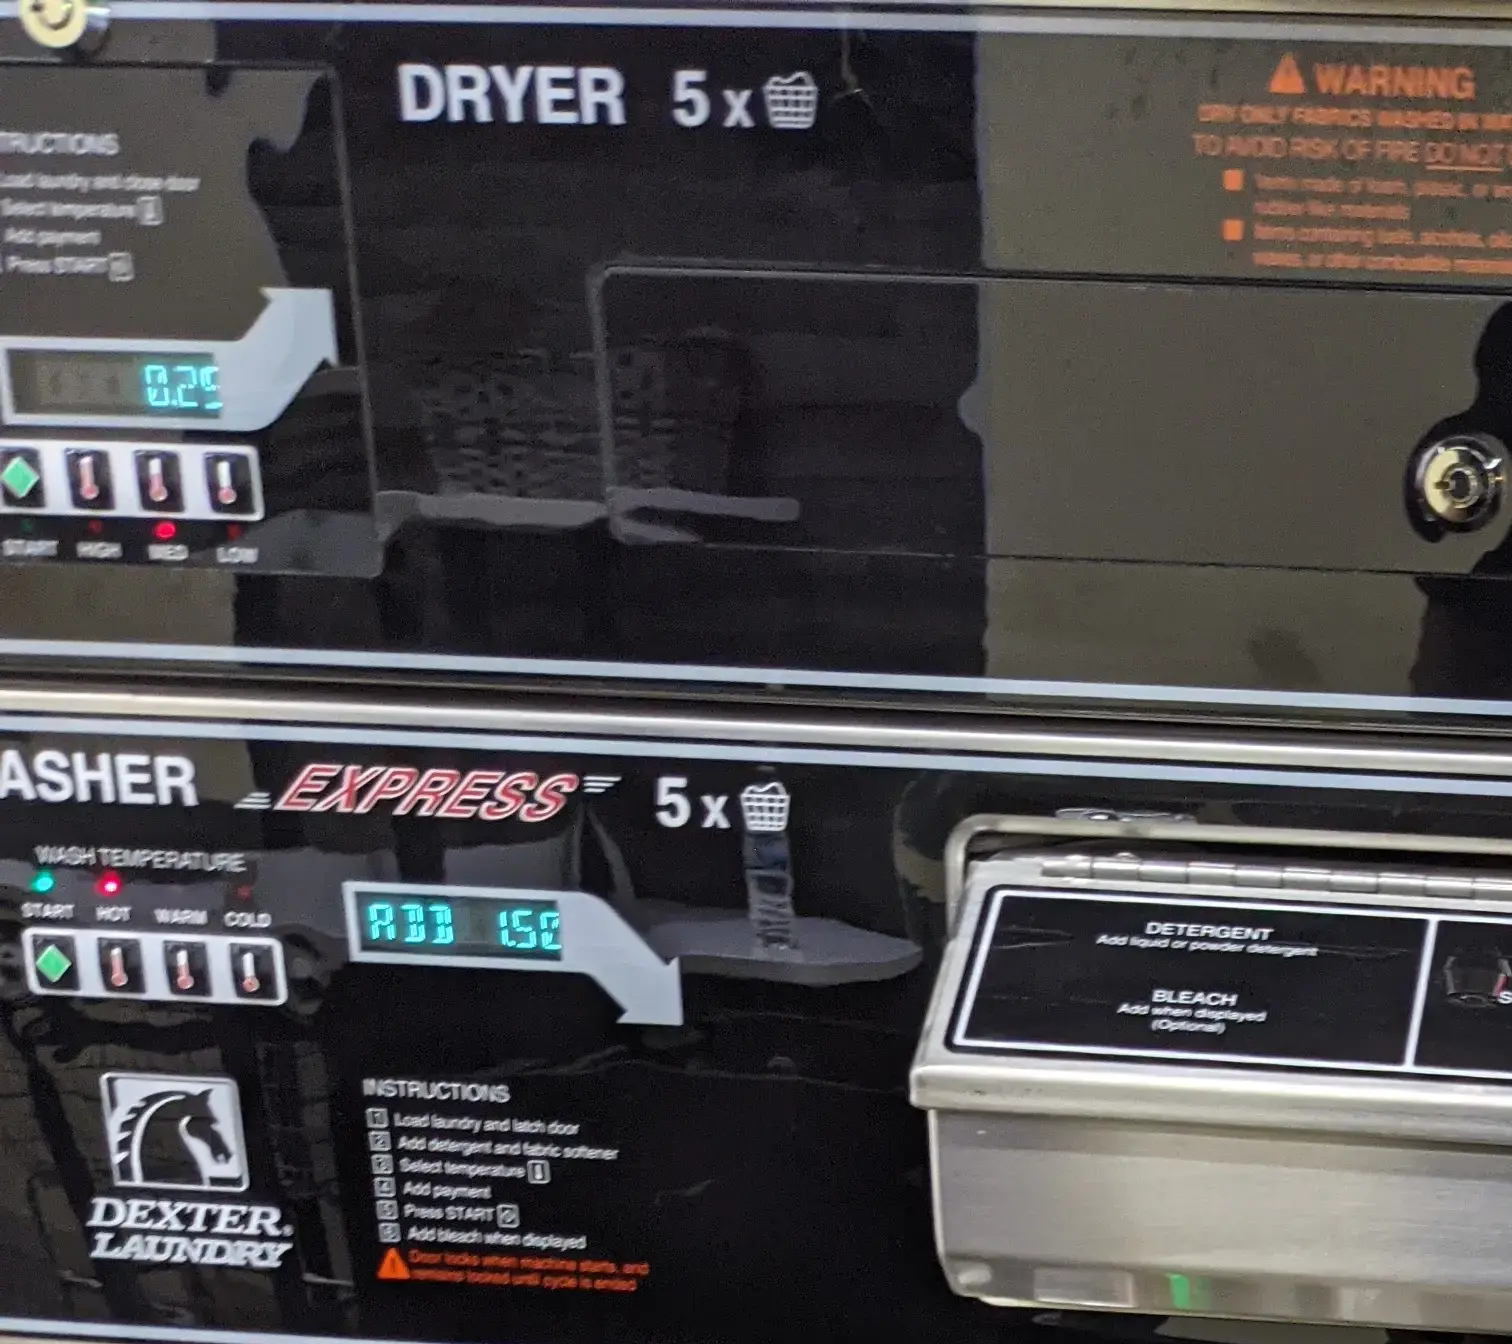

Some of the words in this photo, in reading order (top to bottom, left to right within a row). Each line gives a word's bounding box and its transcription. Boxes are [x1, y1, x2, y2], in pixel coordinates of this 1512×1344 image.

[399, 62, 626, 126] DRYER
[672, 69, 709, 127] 5
[722, 89, 755, 128] x
[1314, 63, 1475, 99] WARNING
[275, 763, 578, 822] EXPRESS
[656, 777, 690, 828] 5
[701, 793, 732, 829] x
[35, 846, 96, 865] WASH
[98, 848, 246, 873] TEMPERATURE
[21, 903, 75, 919] START
[96, 905, 131, 922] HOT
[155, 908, 207, 925] WARM
[224, 911, 271, 928] COLD
[1145, 921, 1274, 941] DETERGENT
[1152, 989, 1238, 1006] BLEACH
[363, 1078, 511, 1103] INSTRUCTIONS
[89, 1232, 293, 1268] LAUNDRY
